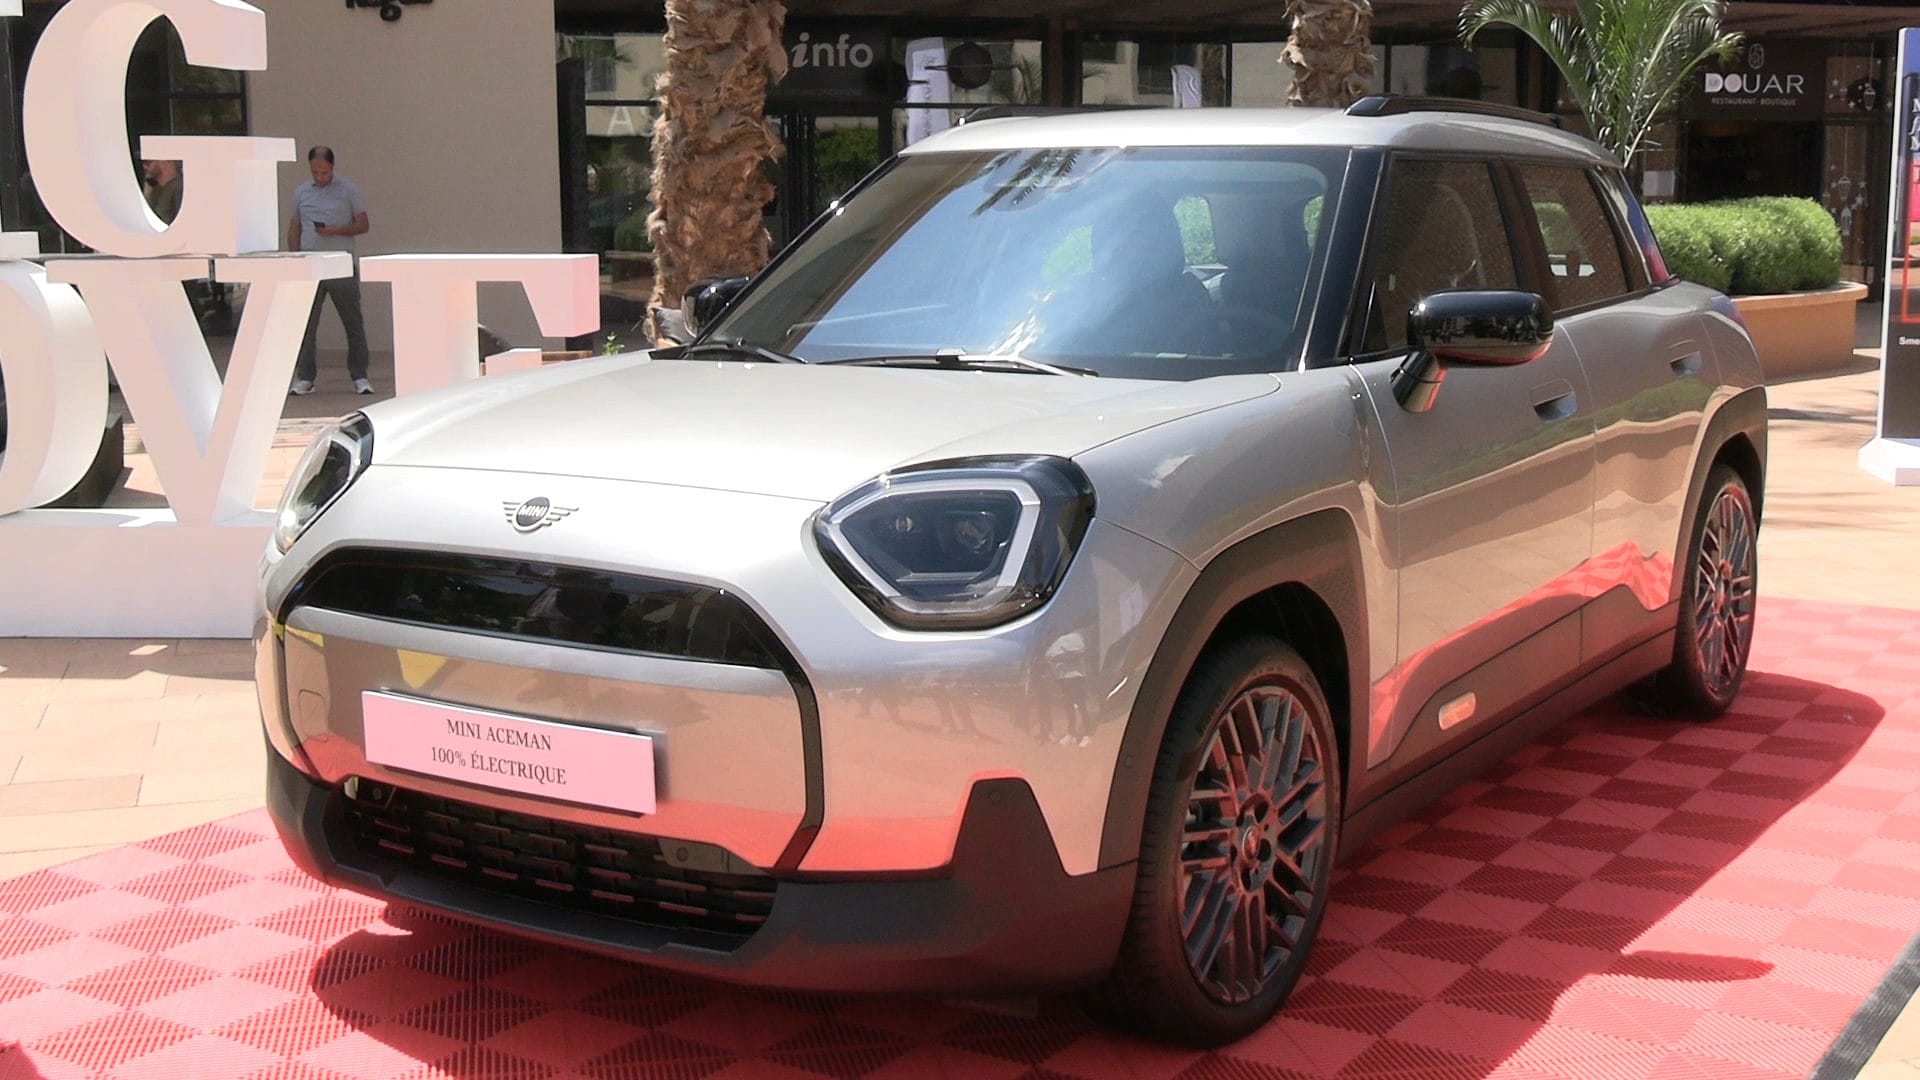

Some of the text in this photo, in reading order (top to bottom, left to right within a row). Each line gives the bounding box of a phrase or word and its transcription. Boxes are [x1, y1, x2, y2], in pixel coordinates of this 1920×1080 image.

[792, 32, 873, 68] info
[1704, 72, 1804, 95] DOUAR
[1711, 97, 1797, 106] RESTAURANT BOUTIQUE
[0, 0, 297, 259] G
[518, 504, 549, 518] MINI
[446, 718, 552, 751] MINI ACEMAN
[431, 746, 567, 785] 100% ÉLECTRIQUE
